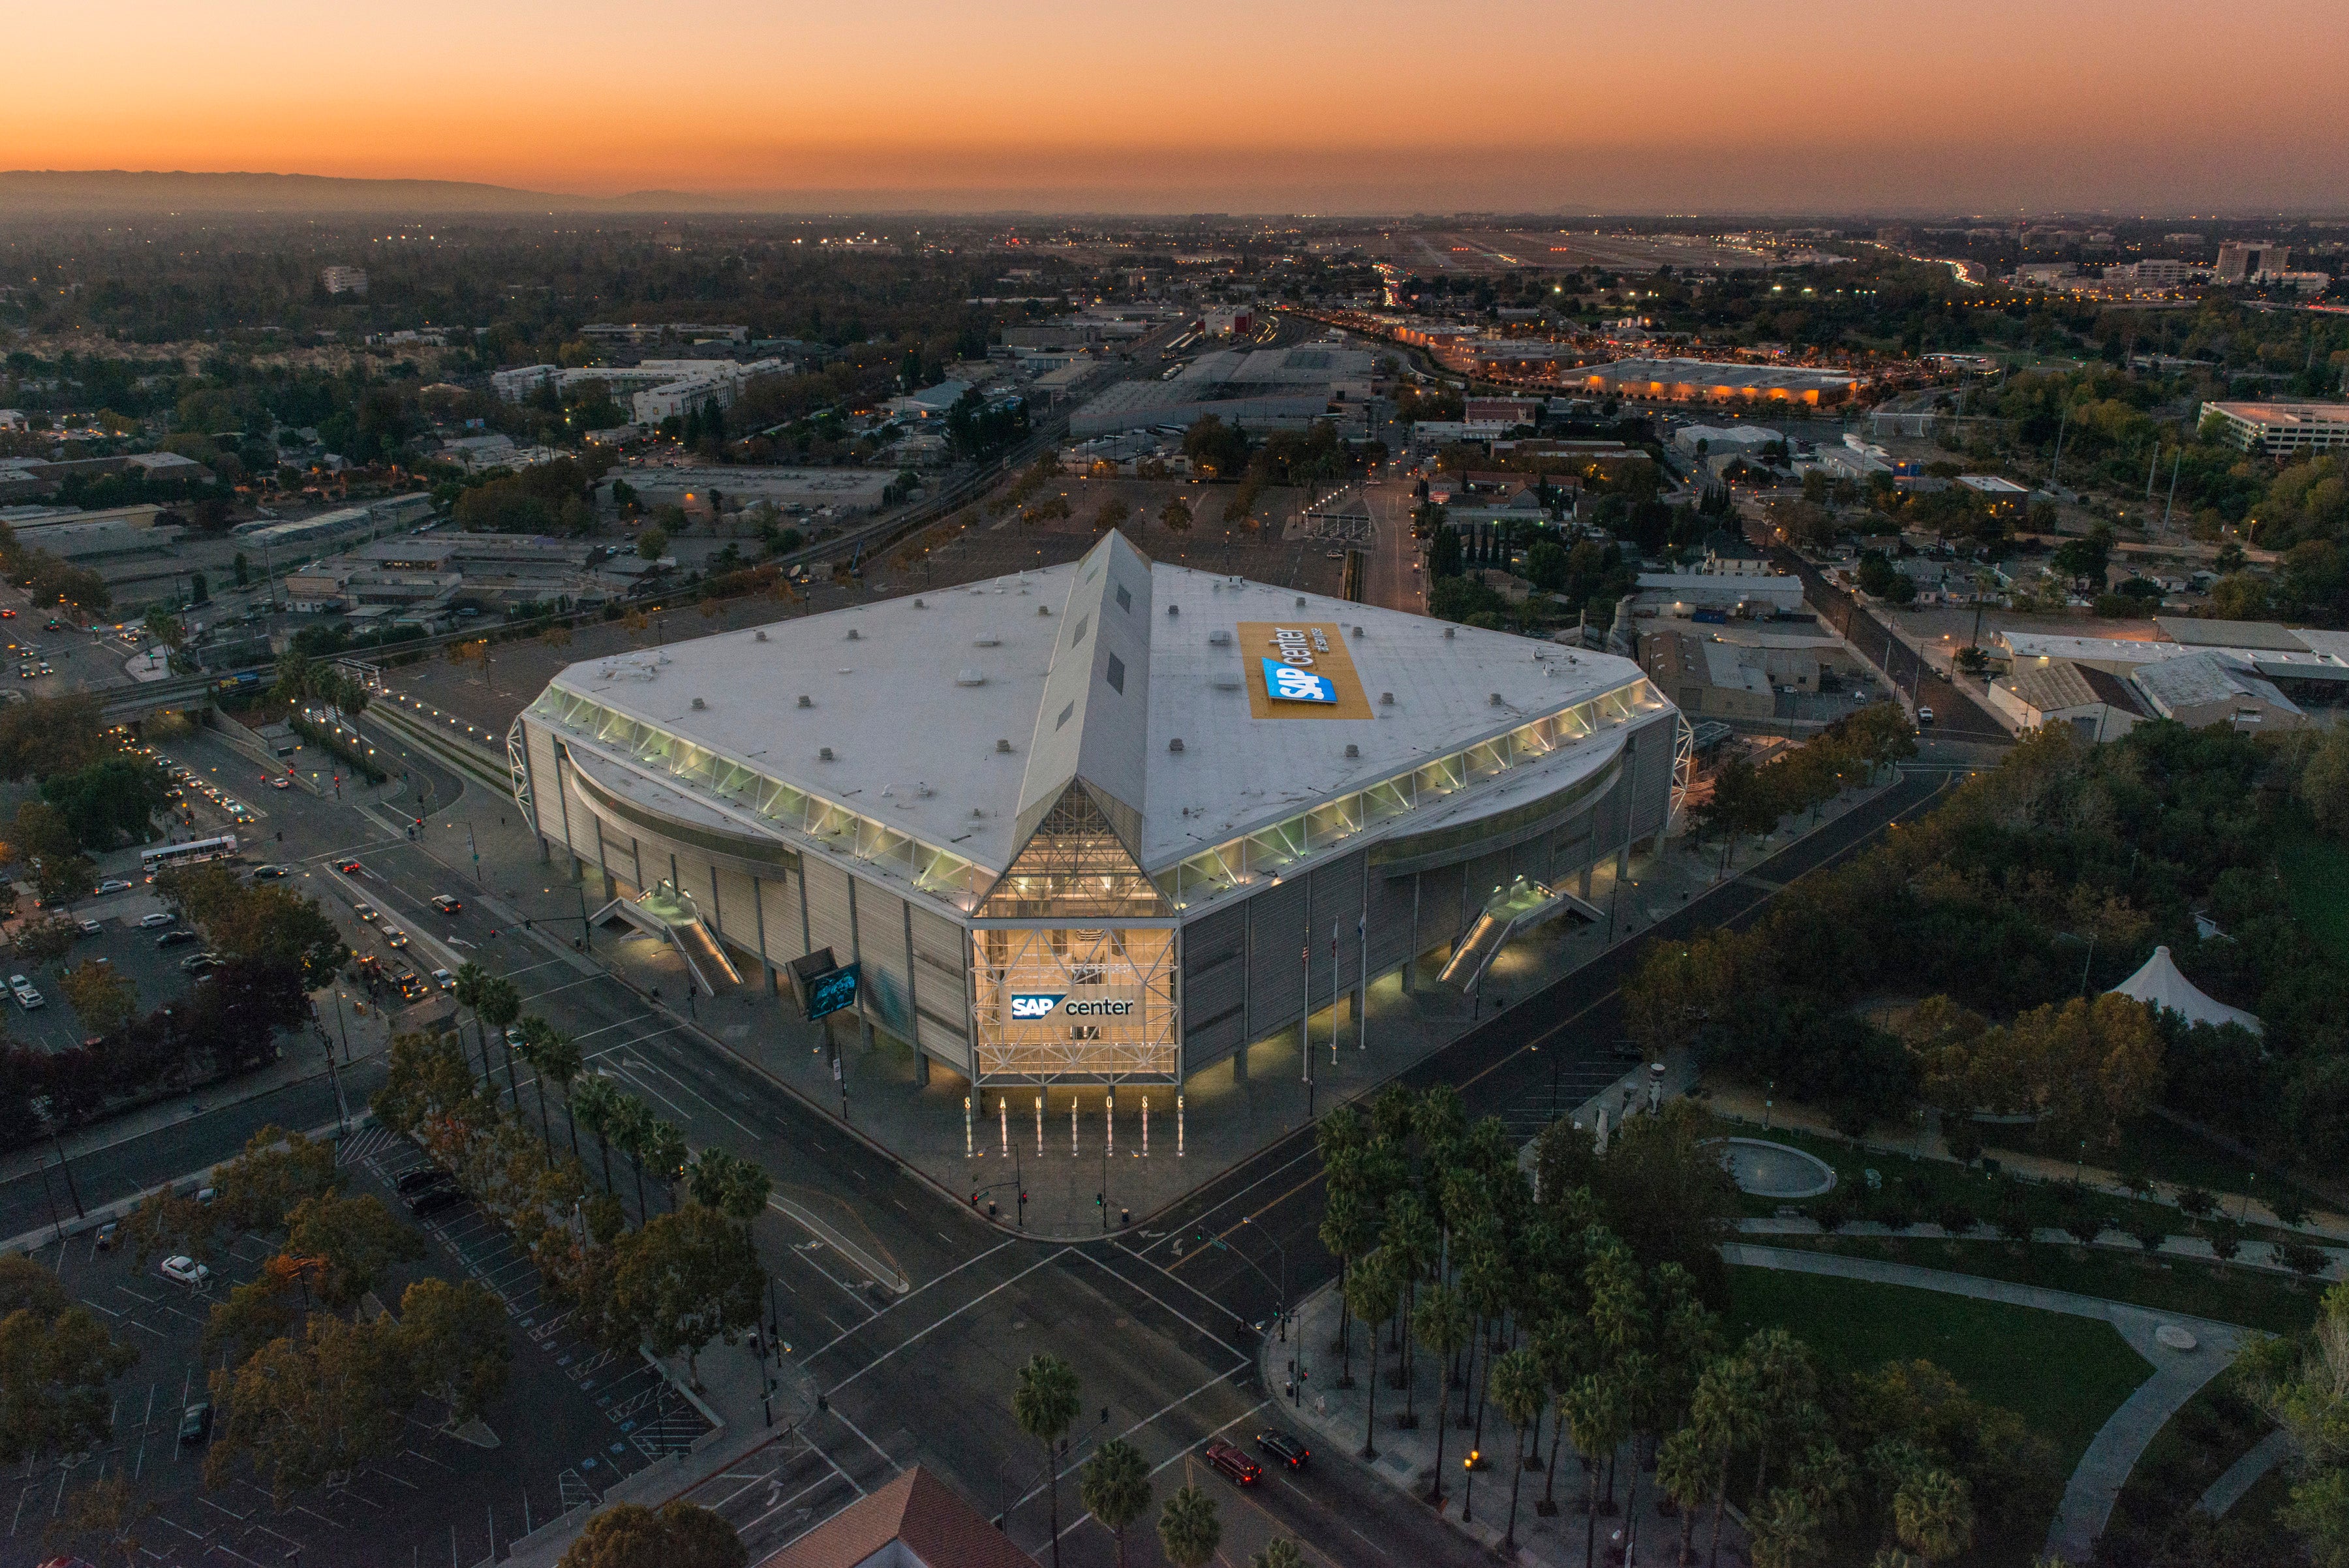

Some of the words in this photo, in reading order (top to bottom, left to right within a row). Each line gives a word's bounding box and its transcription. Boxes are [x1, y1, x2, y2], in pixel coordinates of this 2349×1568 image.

[1268, 628, 1313, 667] center
[1276, 668, 1325, 699] SAP
[1012, 998, 1054, 1015] SAP
[1065, 998, 1134, 1015] center
